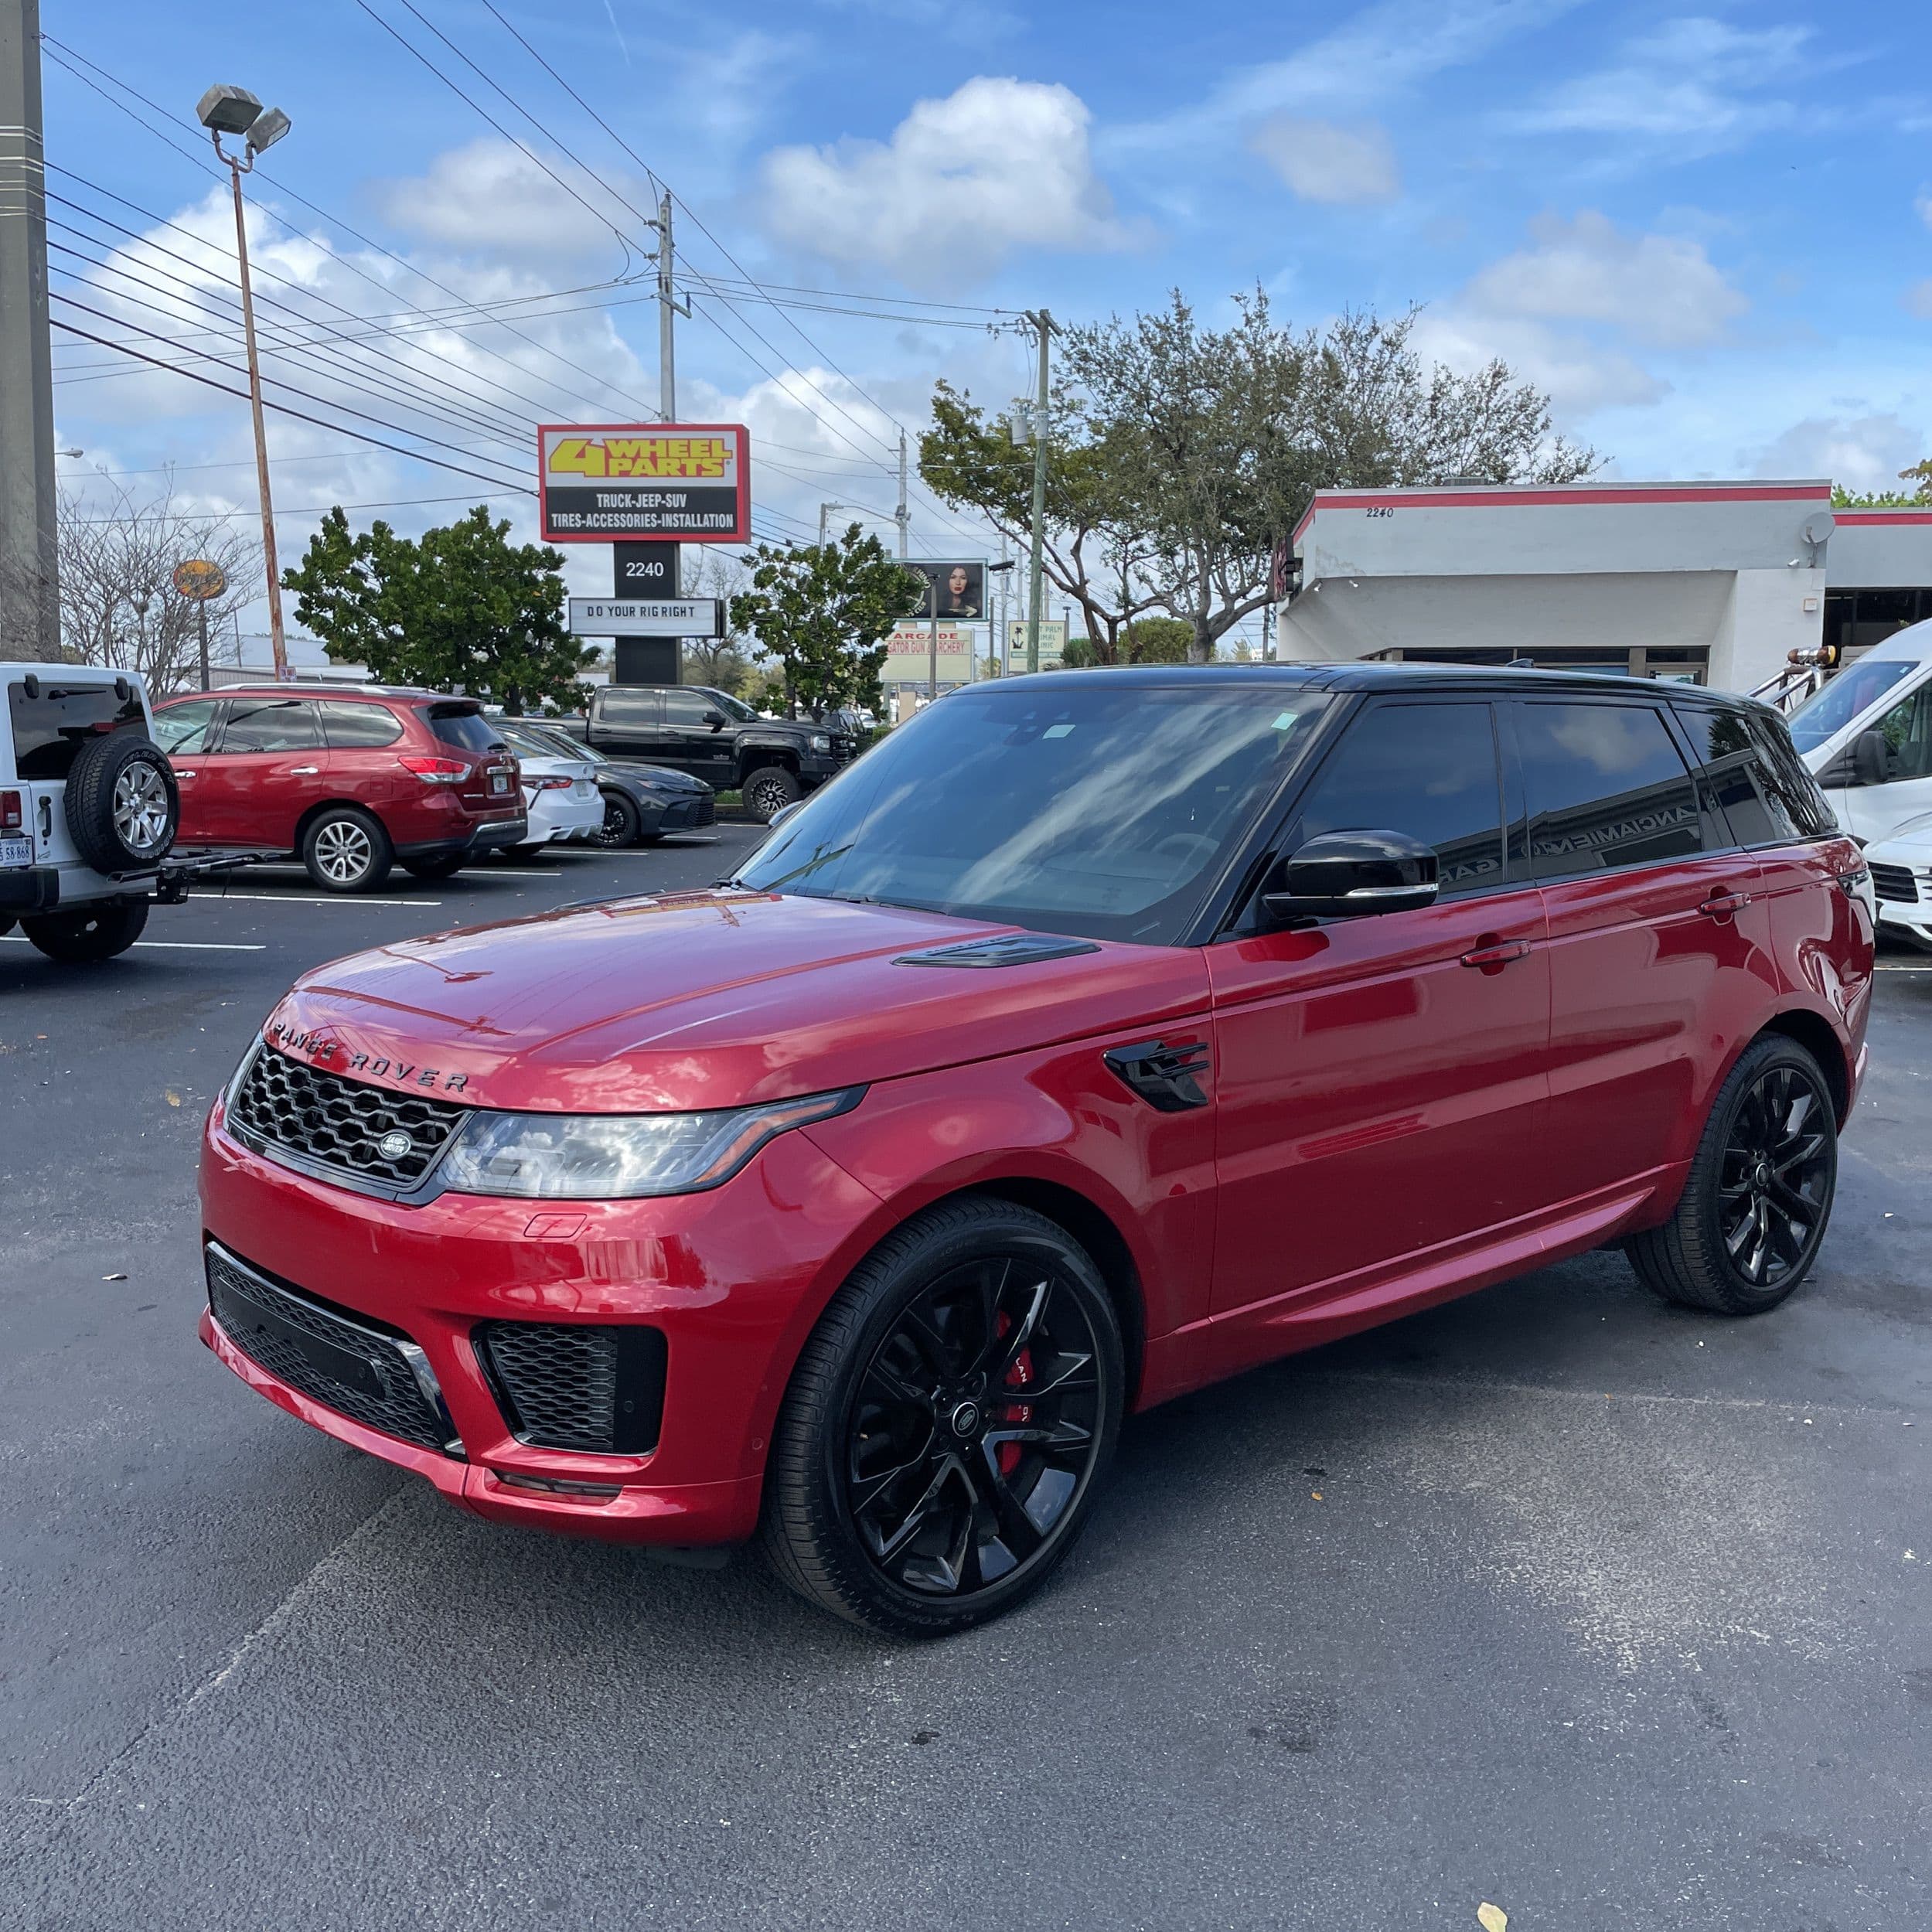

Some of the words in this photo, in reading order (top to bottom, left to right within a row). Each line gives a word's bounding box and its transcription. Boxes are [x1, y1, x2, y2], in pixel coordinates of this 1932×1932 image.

[550, 439, 605, 477] 4
[602, 439, 732, 458] WHEEL
[608, 458, 724, 476] PARTS
[597, 494, 687, 507] TRUCK-JEEP-SUV
[1366, 508, 1394, 517] 2240
[552, 513, 733, 527] TIRES-ACCESSORIES-INSTALLATION
[625, 562, 664, 577] 2240
[588, 606, 602, 616] DO
[608, 606, 635, 616] YOUR
[640, 606, 658, 617] RIG
[662, 607, 695, 616] RIGHT
[888, 642, 910, 653] GATOR
[911, 642, 925, 653] GUN
[935, 642, 965, 653] RCHERY
[274, 1021, 338, 1061] RANGE
[350, 1051, 469, 1092] ROVER
[1016, 1357, 1027, 1382] LAN
